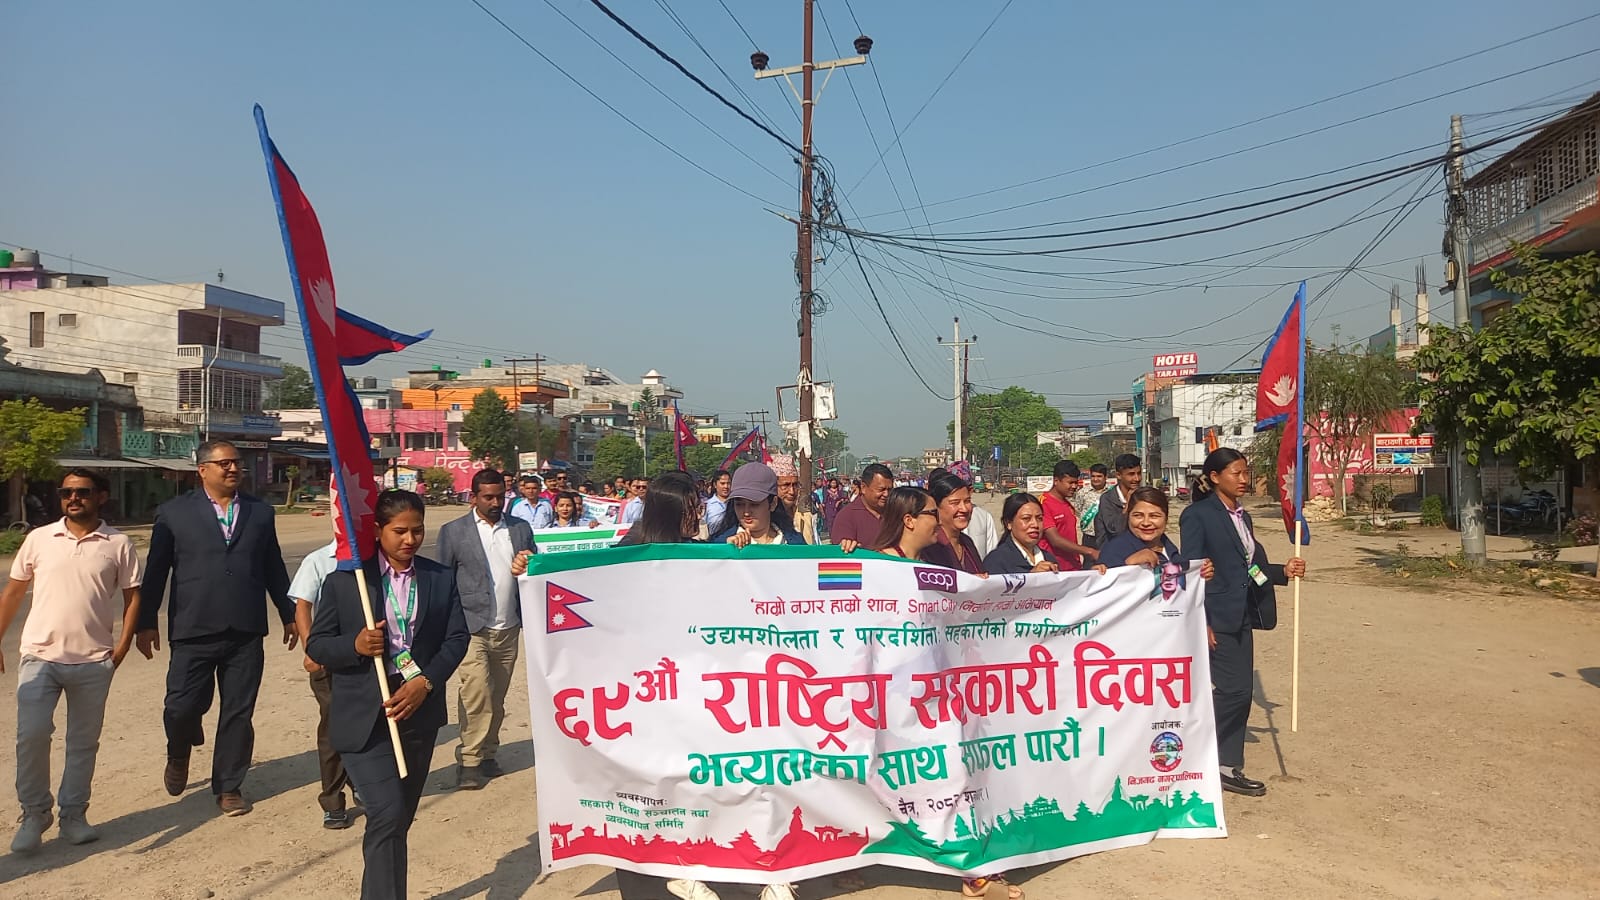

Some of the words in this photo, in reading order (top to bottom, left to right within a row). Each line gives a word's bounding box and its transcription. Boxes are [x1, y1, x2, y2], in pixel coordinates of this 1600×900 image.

[1156, 354, 1196, 366] HOTEL
[790, 599, 826, 615] नगर
[829, 594, 862, 614] हाम्रो
[867, 598, 900, 615] शान,
[908, 599, 939, 614] Smart
[830, 628, 845, 649] र
[945, 617, 1008, 646] सहकारीको
[701, 653, 893, 752] राष्ट्रिय
[910, 644, 1059, 730] सहकारी
[1073, 640, 1193, 712] दिवस
[877, 744, 949, 791] साथ
[579, 799, 615, 811] सहकारी
[618, 802, 641, 817] दिवस
[690, 809, 710, 818] तथा
[605, 814, 650, 830] व्यवस्थापन
[654, 818, 685, 829] समिति
